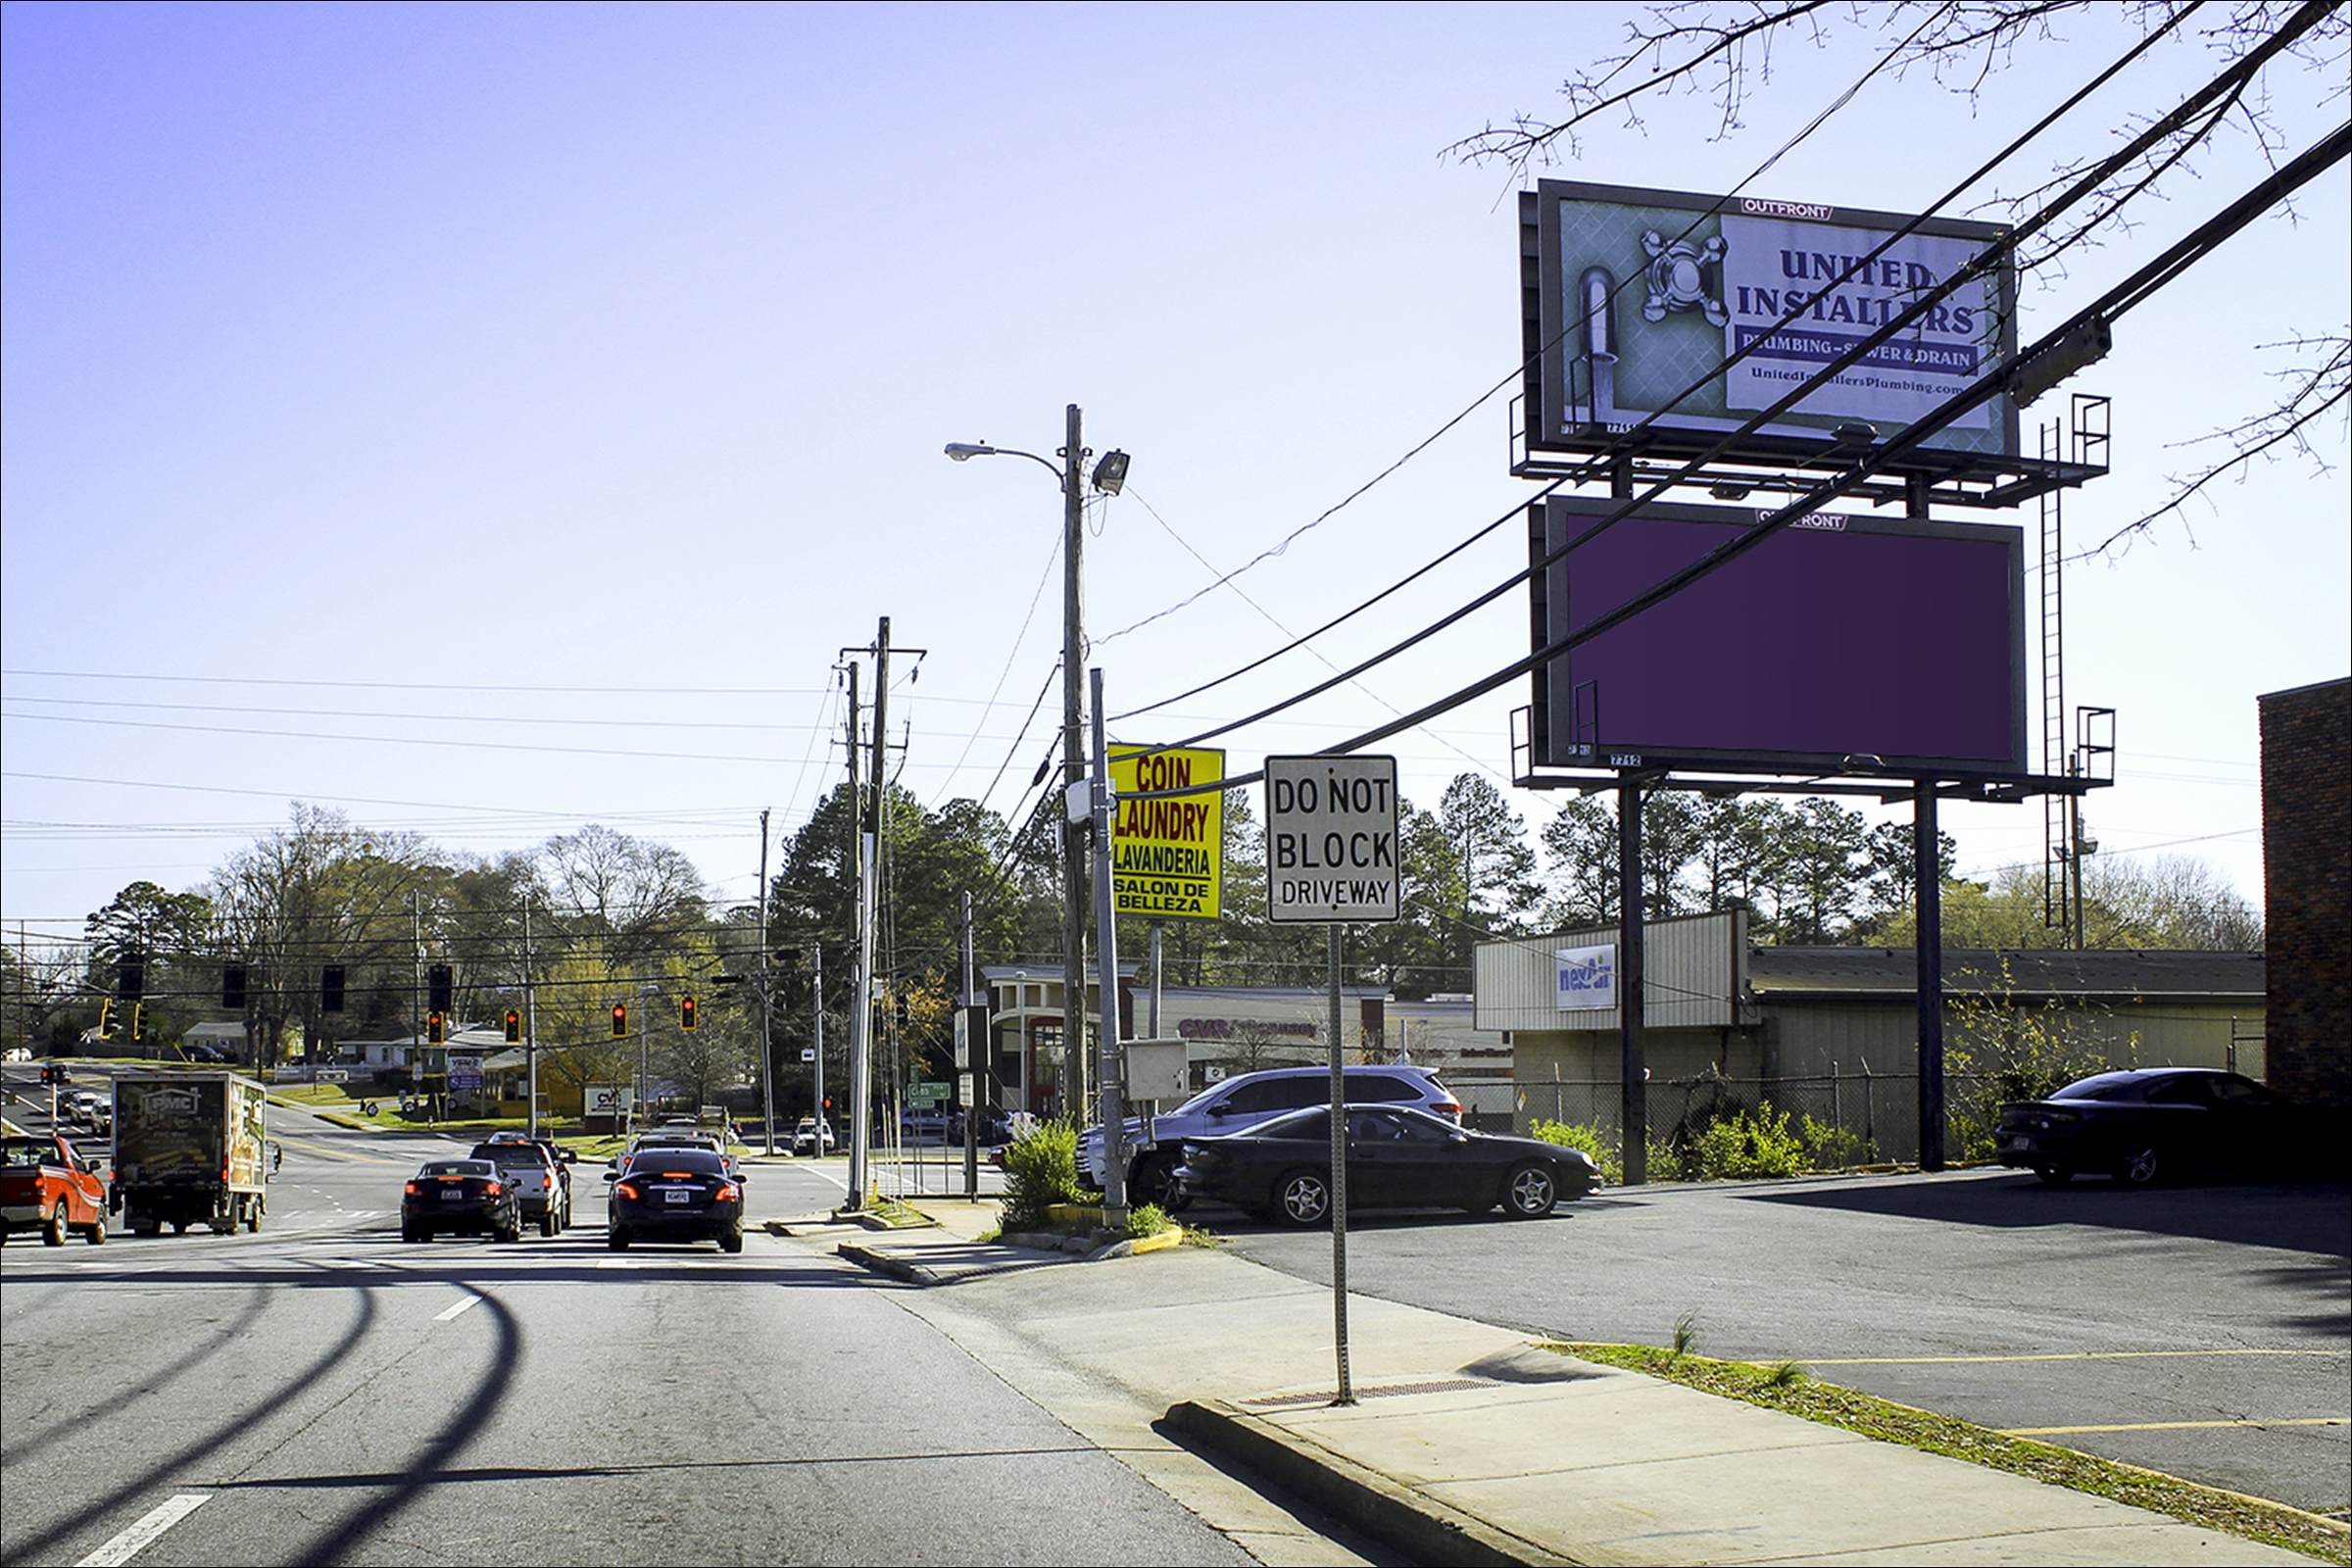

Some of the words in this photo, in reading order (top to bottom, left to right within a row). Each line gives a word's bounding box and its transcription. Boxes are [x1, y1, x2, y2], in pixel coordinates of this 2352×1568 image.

[1744, 199, 1828, 218] OUTFRONT
[1780, 250, 1931, 290] UNITED
[1742, 334, 1900, 362] PUMBING-SWER
[1751, 368, 1965, 394] UnitedInallersPlumbing.com
[1759, 510, 1842, 527] ORONT
[1136, 755, 1191, 793] COIN
[1275, 777, 1318, 814] DO
[1329, 777, 1391, 814] NOT
[1115, 799, 1209, 843] LAUNDRY
[1113, 844, 1210, 875] LAVANDERIA
[1277, 831, 1394, 868] BLOCK
[1113, 878, 1179, 896] SALON
[1184, 883, 1208, 898] DE
[1282, 880, 1391, 905] DRIVEWAY
[1117, 894, 1202, 913] BELLEZA
